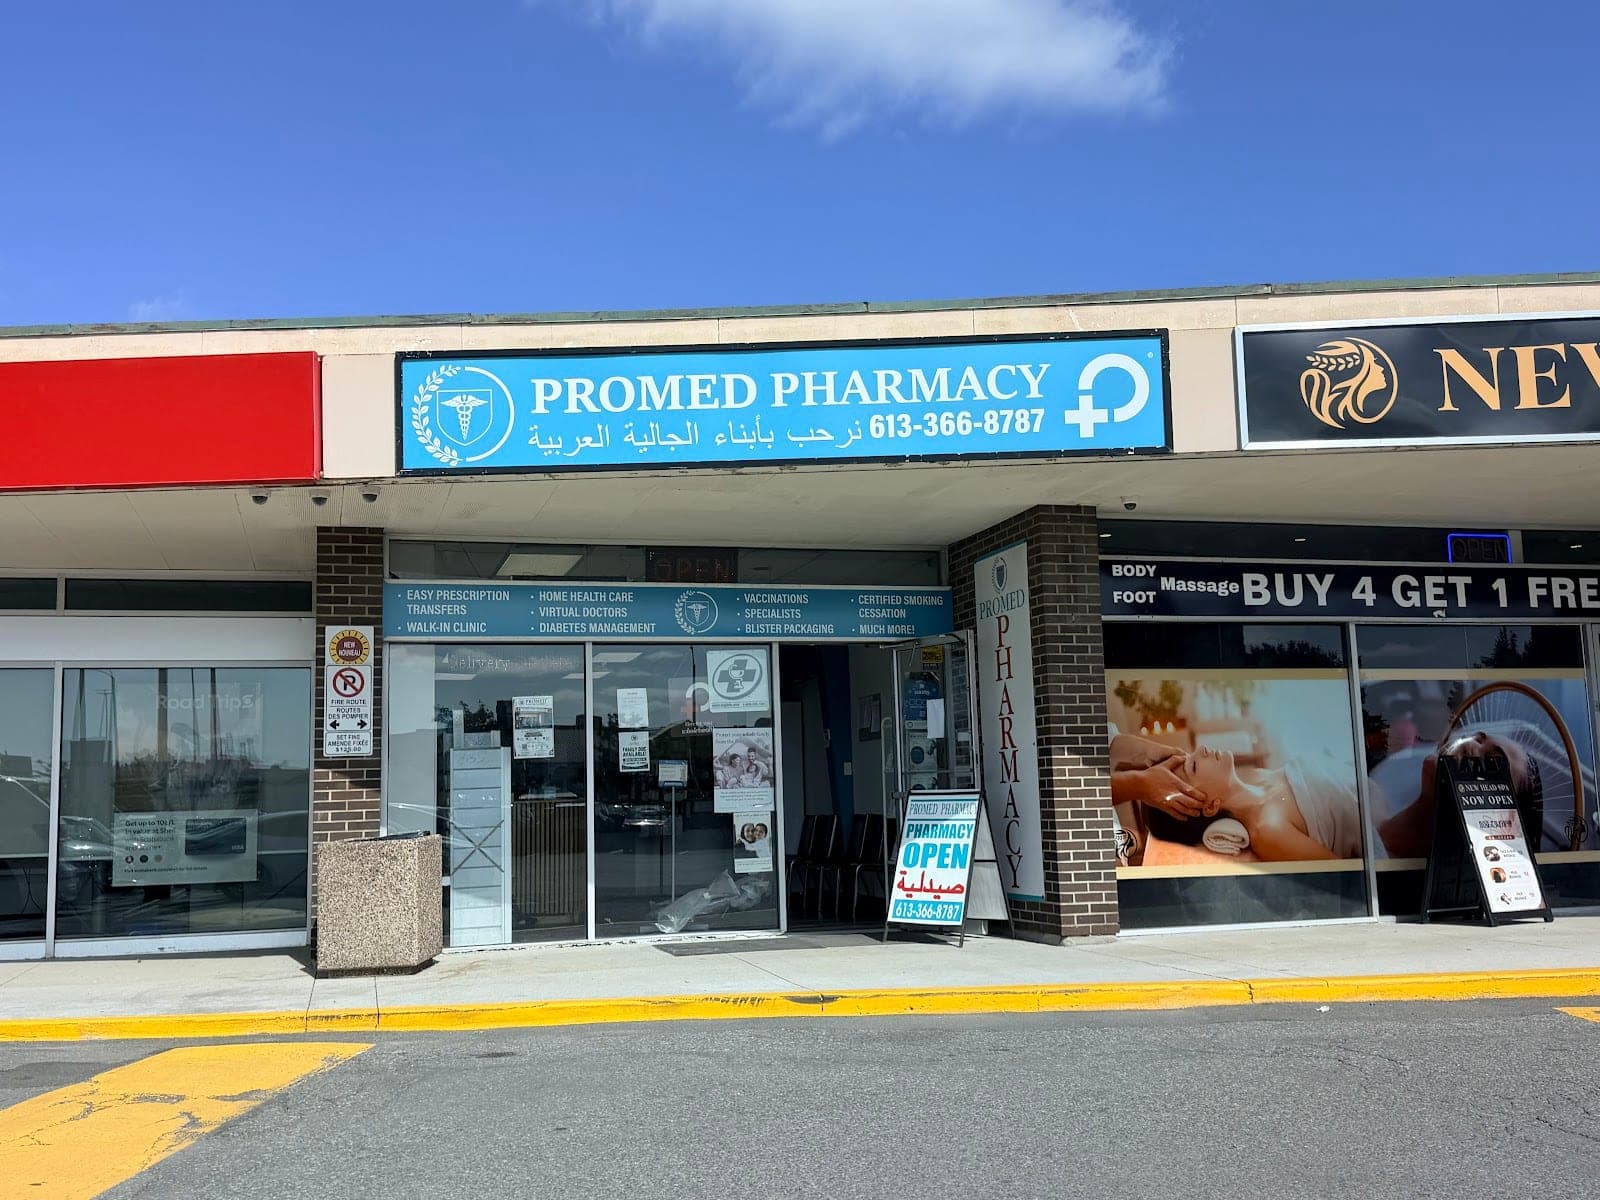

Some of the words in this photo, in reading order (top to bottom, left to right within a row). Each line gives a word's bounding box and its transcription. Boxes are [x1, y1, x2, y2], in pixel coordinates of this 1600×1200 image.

[531, 373, 757, 413] PROMED
[771, 363, 1051, 407] PHARMACY
[869, 408, 1044, 439] 613-366-8787
[624, 420, 699, 453] الجالية
[715, 414, 774, 447] بأبناء
[787, 419, 863, 448] نرحب
[528, 423, 610, 456] العربية
[1112, 565, 1157, 577] BODY
[407, 590, 435, 601] EASY
[436, 590, 510, 601] PRESCRIPTION
[539, 591, 568, 602] HOME
[570, 591, 606, 602] HEALTH
[608, 592, 634, 602] CARE
[1160, 577, 1240, 597] Massage
[1242, 573, 1335, 607] BUY
[1351, 576, 1376, 607] 4
[1392, 575, 1472, 608] GET
[1491, 578, 1508, 608] 1
[744, 593, 809, 604] VACCINATIONS
[858, 595, 902, 605] CERTIFIED
[903, 595, 944, 606] SMOKING
[1113, 591, 1156, 604] FOOT
[407, 604, 467, 615] TRANSFERS
[979, 589, 1025, 620] PROMED
[539, 607, 580, 617] VIRTUAL
[582, 607, 628, 618] DOCTORS
[745, 608, 801, 619] SPECIALISTS
[859, 608, 906, 618] CESSATION
[407, 622, 451, 633] WALK-IN
[453, 622, 487, 633] CLINIC
[539, 622, 587, 633] DIABETES
[589, 622, 656, 633] MANAGEMENT
[745, 623, 782, 634] BLISTER
[784, 624, 834, 635] PACKAGING
[859, 624, 885, 634] MUCH
[887, 624, 915, 635] MORE!
[344, 641, 355, 649] NEW
[338, 649, 360, 657] NOUVEAU
[994, 614, 1023, 888] PHARMACY
[1461, 795, 1485, 806] NOW
[1488, 795, 1514, 805] OPEN
[909, 803, 939, 815] PROMED
[906, 823, 975, 839] PHARMACY
[903, 842, 969, 869] OPEN
[897, 870, 965, 899] صيدلية
[895, 903, 960, 919] 613-366-8787
